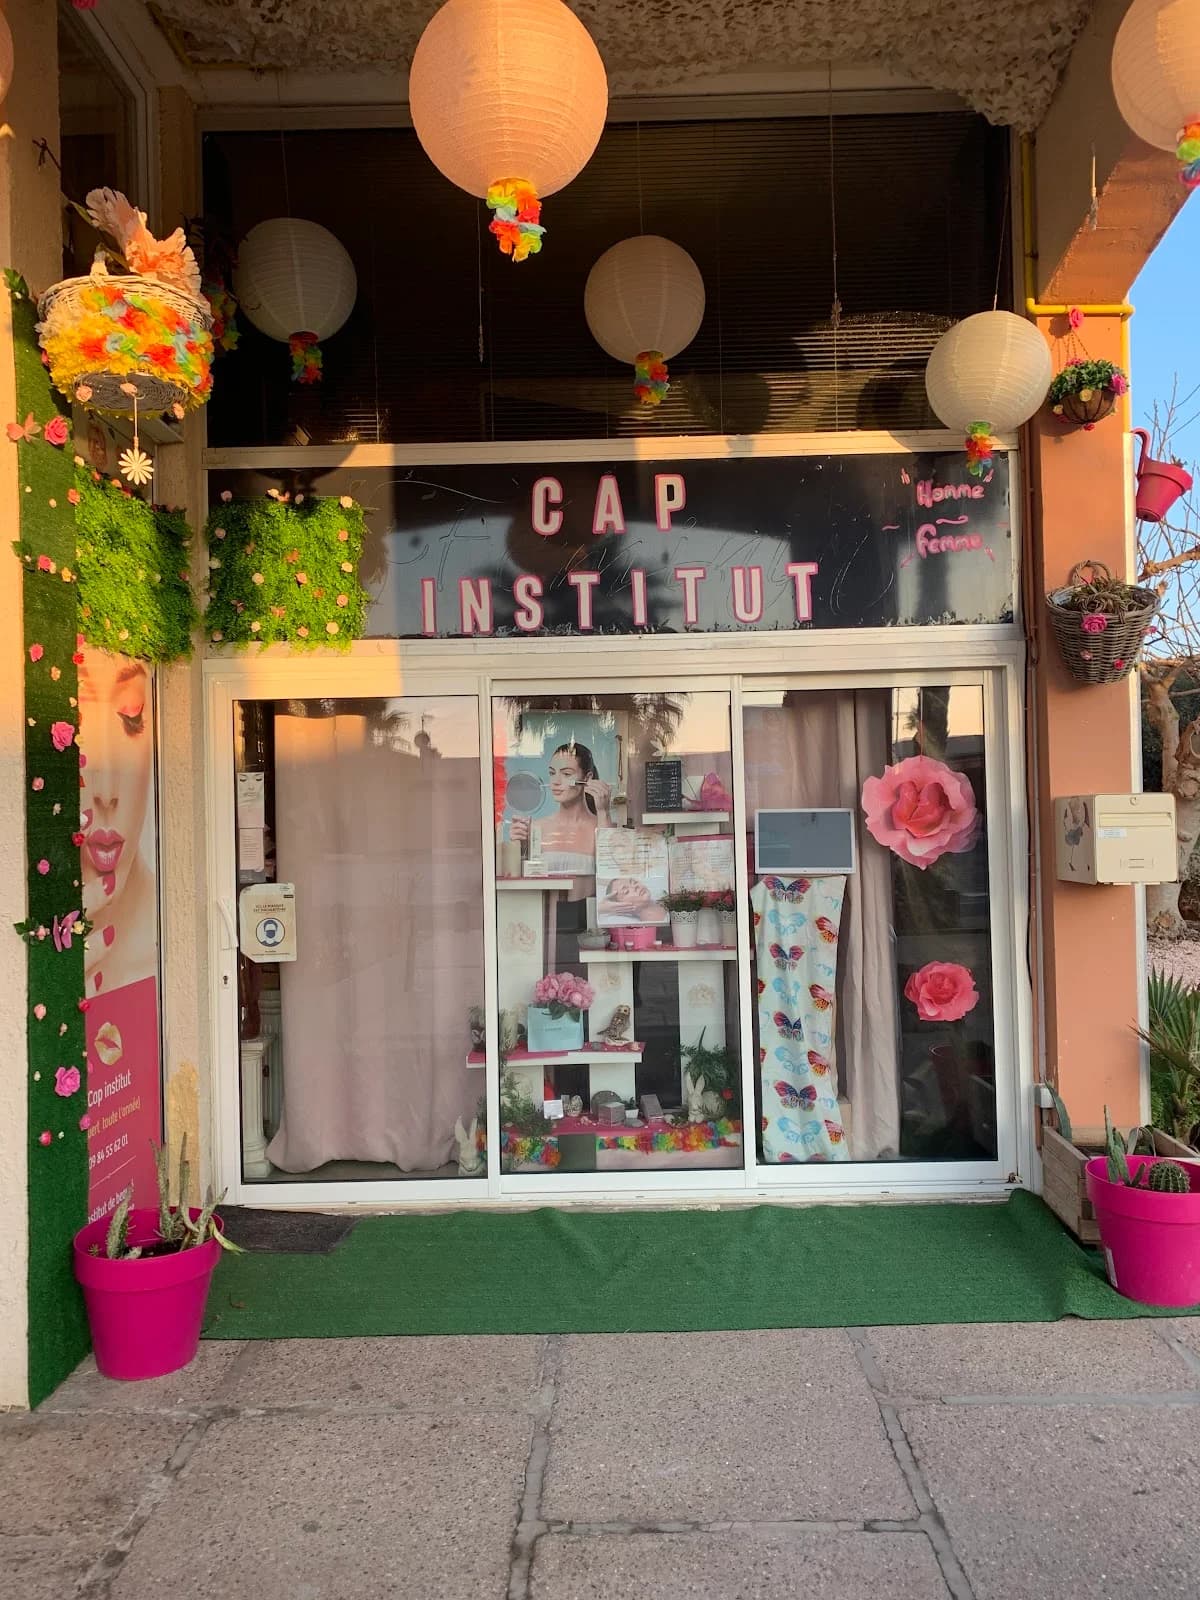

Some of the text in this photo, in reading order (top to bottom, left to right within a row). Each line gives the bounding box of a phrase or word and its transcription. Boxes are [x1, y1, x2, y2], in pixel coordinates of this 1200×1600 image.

[531, 473, 687, 535] CAP
[916, 480, 985, 508] Homme
[421, 562, 819, 637] INSTITUT
[87, 1069, 132, 1108] Cap institut
[102, 1111, 119, 1130] toute
[105, 1142, 113, 1159] 55
[113, 1137, 121, 1153] 62
[121, 1132, 129, 1147] 01
[107, 1194, 116, 1212] de
